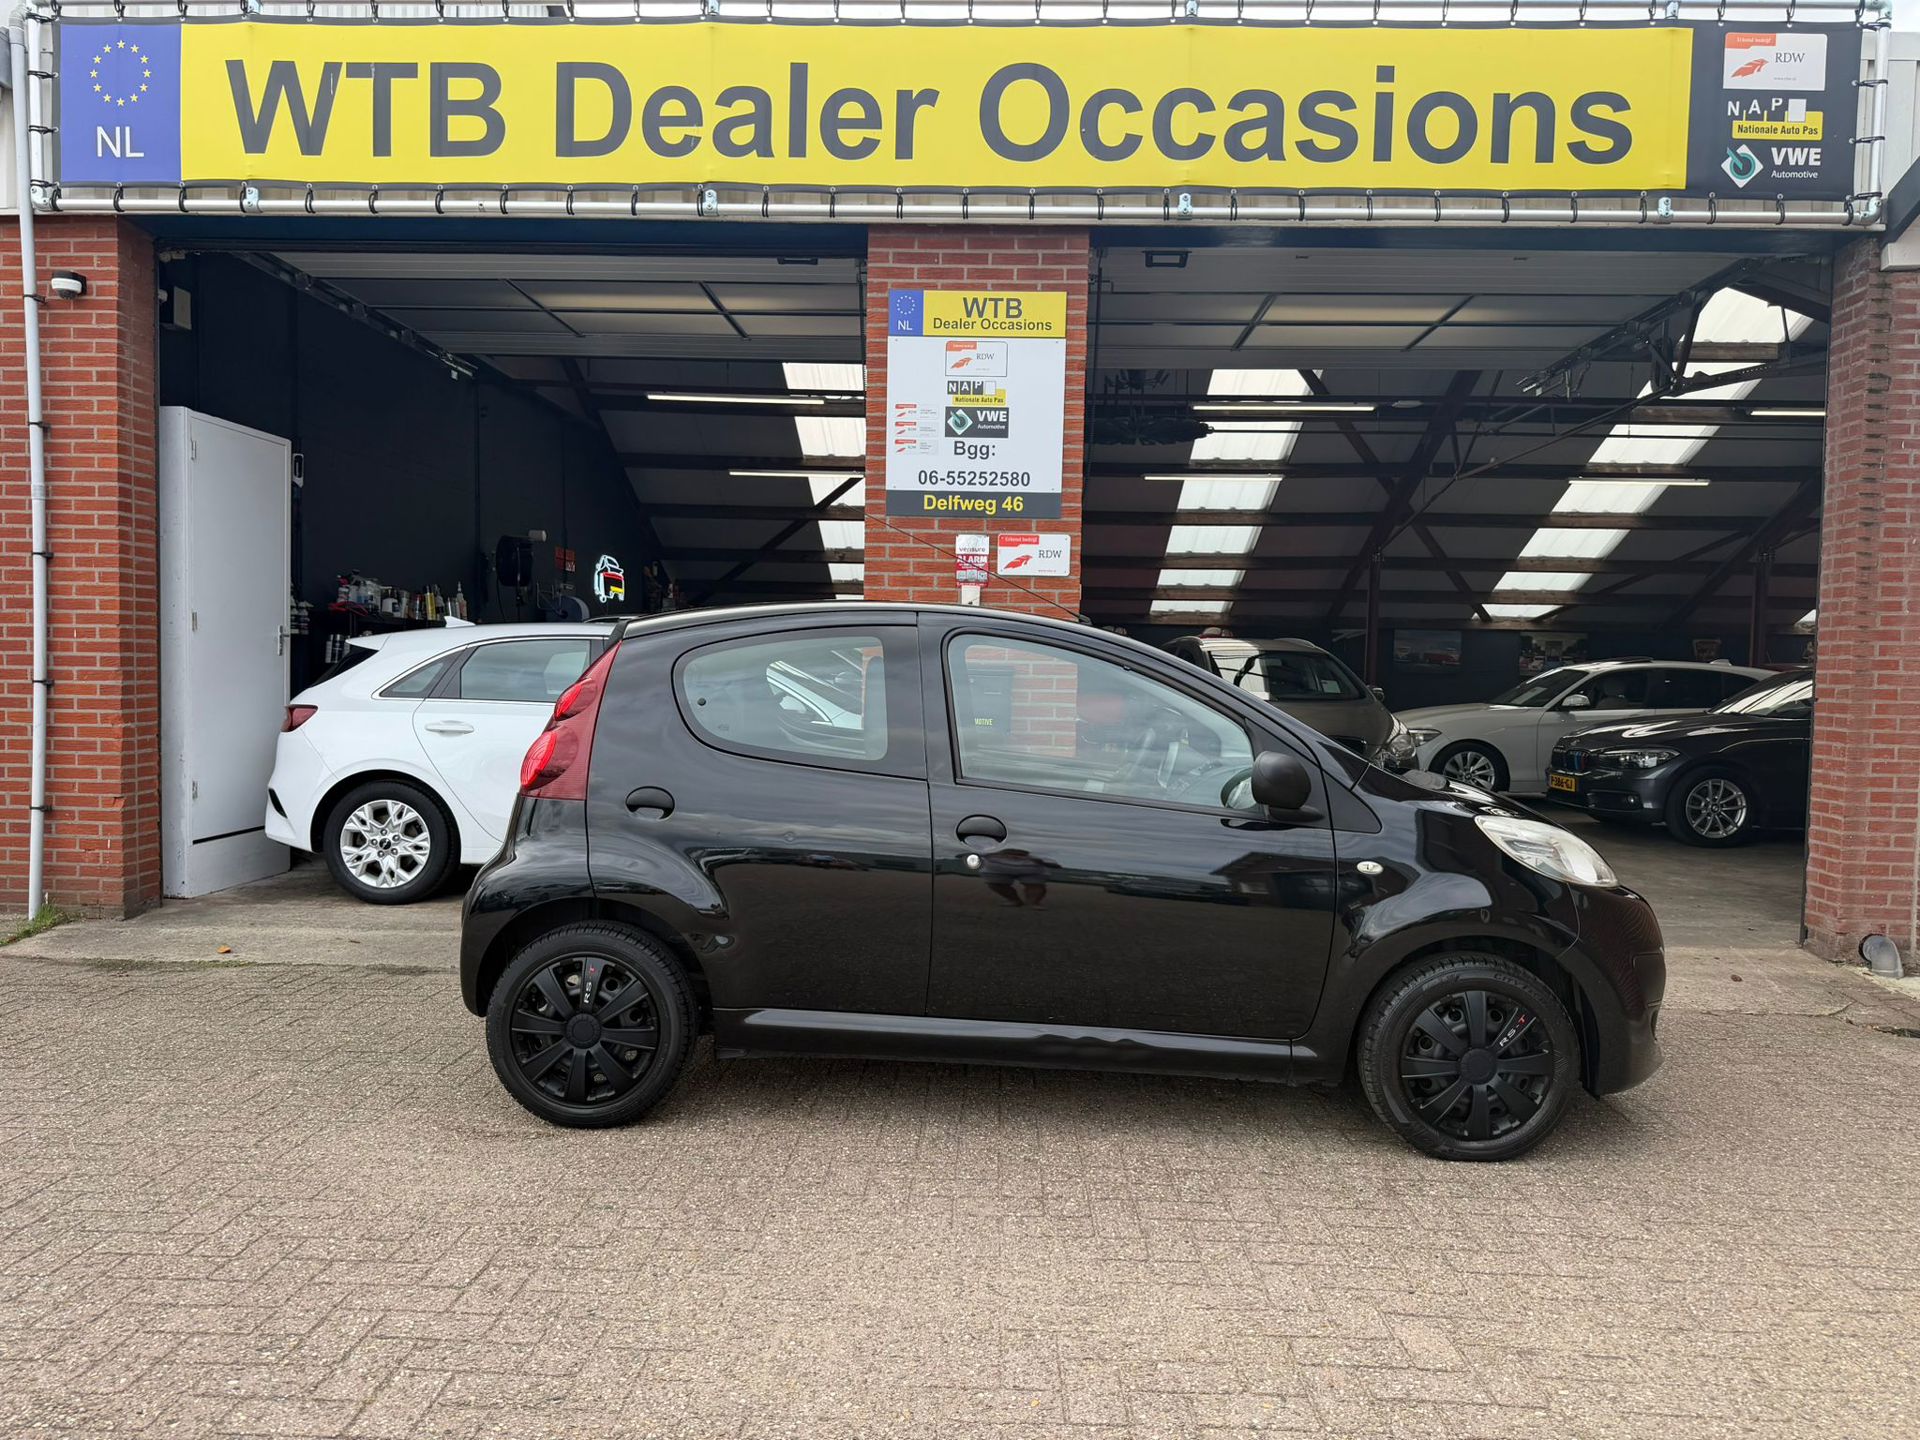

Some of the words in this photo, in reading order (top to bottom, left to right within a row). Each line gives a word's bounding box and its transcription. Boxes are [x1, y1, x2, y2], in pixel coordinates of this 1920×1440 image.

[1775, 52, 1806, 64] RDW
[226, 59, 506, 158] WTB
[556, 62, 940, 161] Dealer
[979, 62, 1633, 164] Occasions
[1737, 124, 1778, 135] Nationale
[1780, 125, 1800, 135] Auto
[1803, 125, 1819, 135] Pas
[96, 126, 144, 159] NL
[1771, 147, 1822, 166] VWE
[1771, 170, 1818, 179] Automotive
[963, 297, 1023, 319] WTB
[897, 319, 913, 331] NL
[933, 318, 976, 329] Dealer
[981, 318, 1052, 331] Occasions
[976, 352, 995, 360] RDW
[994, 396, 1004, 404] Pas
[977, 410, 1008, 422] VWE
[954, 441, 996, 460] Bgg:
[918, 470, 1031, 487] 06-55252580
[923, 495, 998, 515] Delfweg
[1001, 496, 1024, 512] 46
[957, 555, 988, 564] ALARM
[1038, 549, 1063, 559] RDW
[1499, 1014, 1527, 1047] RS-T
